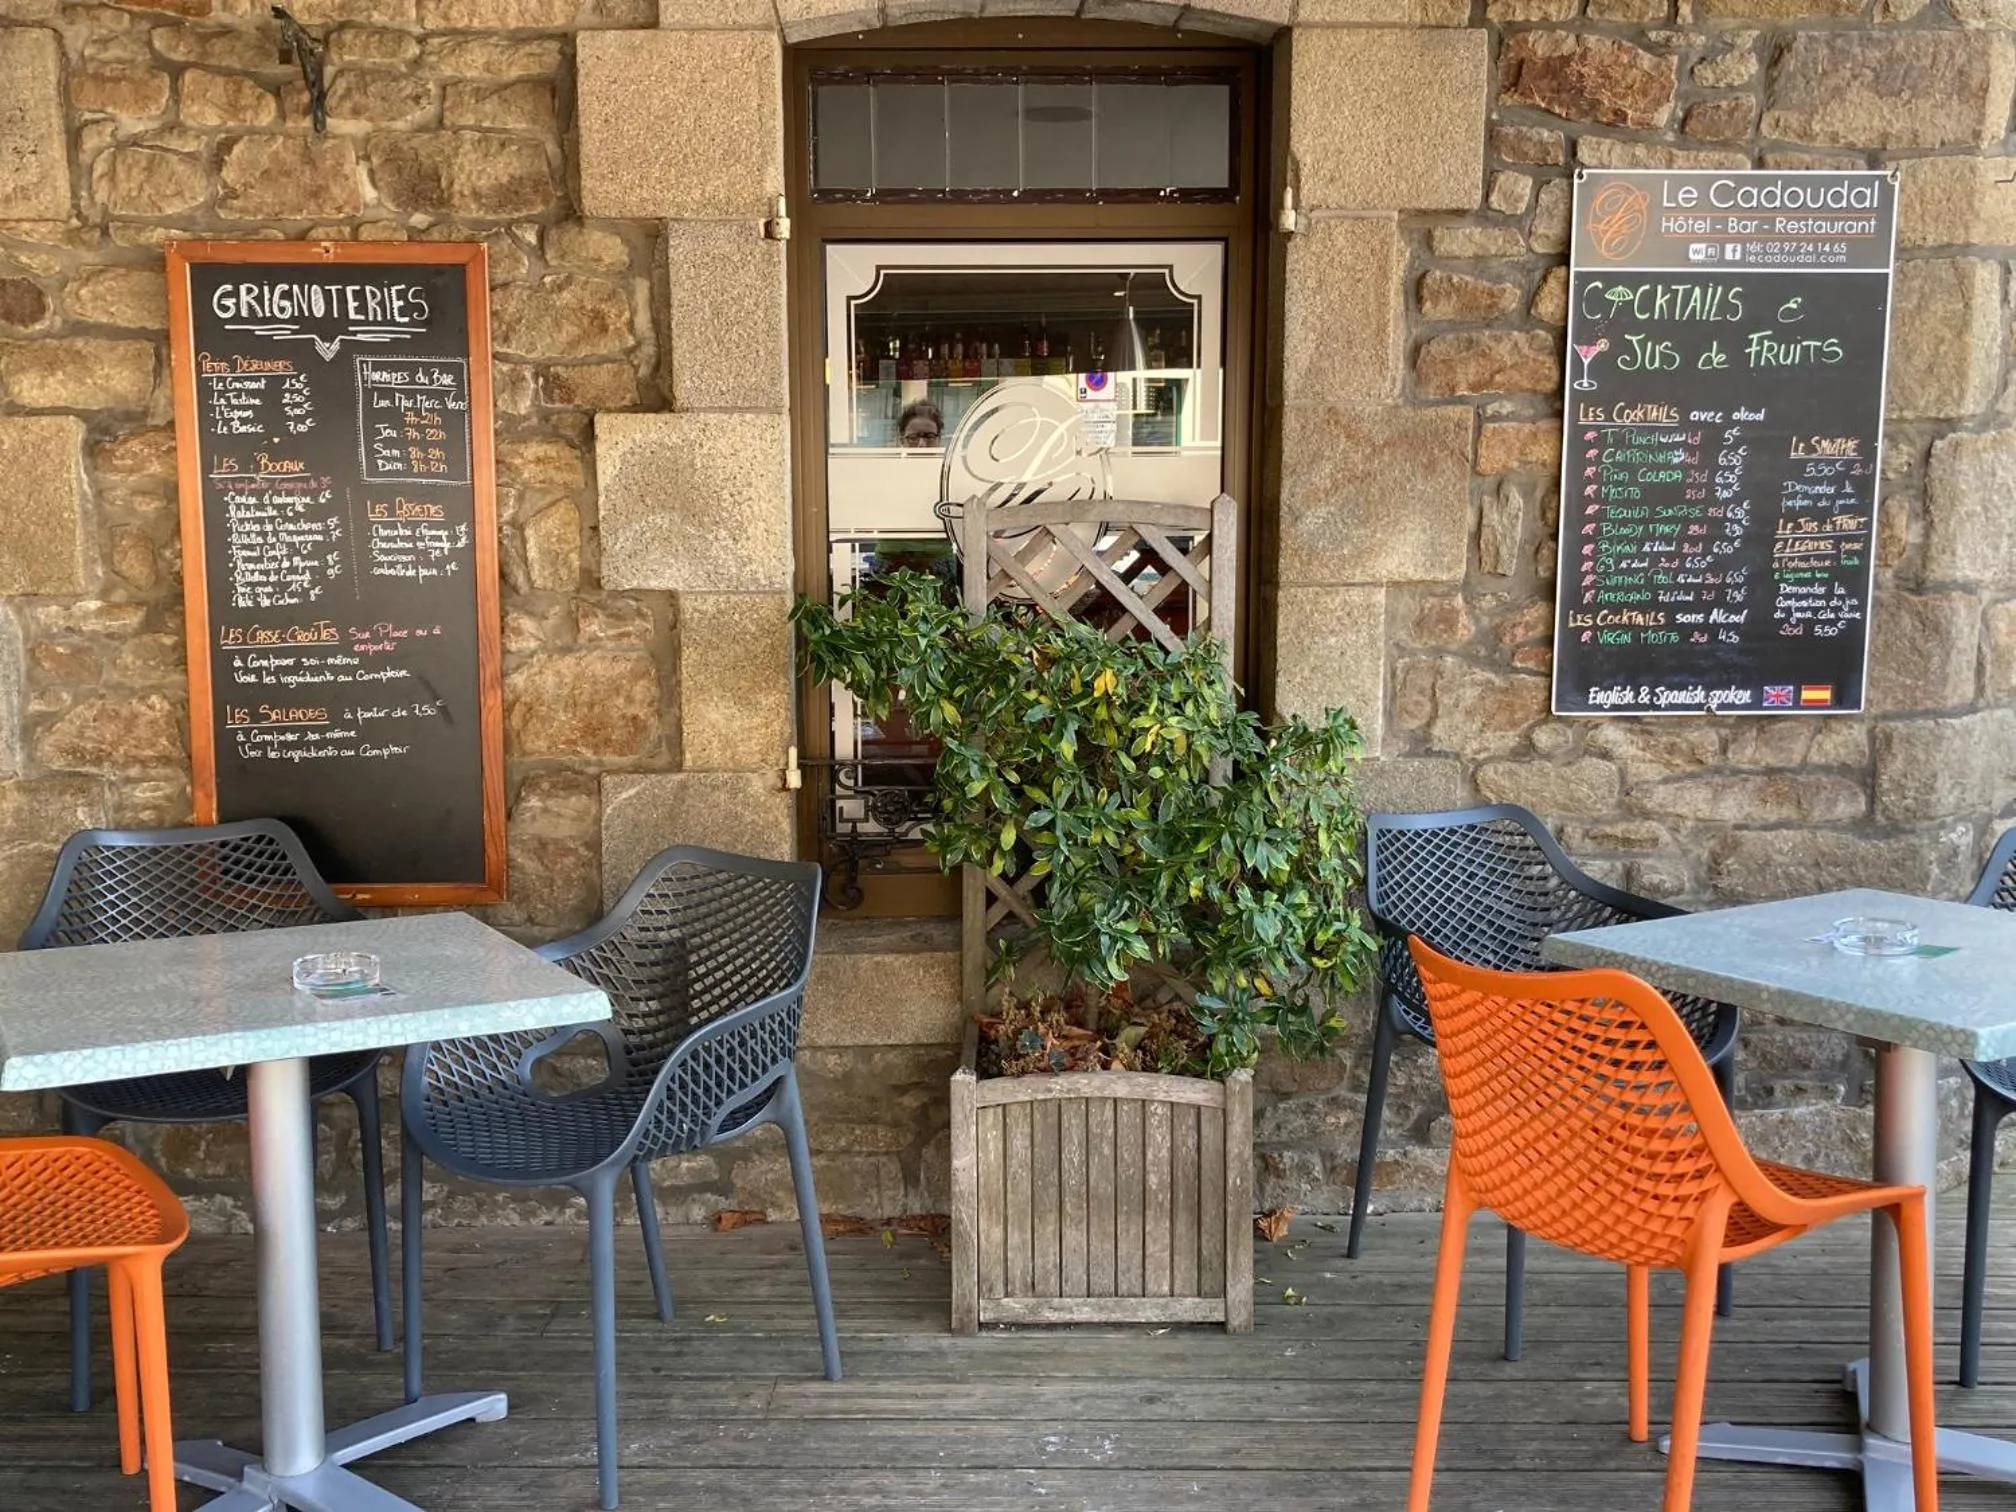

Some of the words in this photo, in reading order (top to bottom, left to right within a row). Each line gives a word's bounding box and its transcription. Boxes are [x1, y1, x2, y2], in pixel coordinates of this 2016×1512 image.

[1662, 179, 1697, 208] Le
[1709, 179, 1879, 209] Cadoudal
[1661, 216, 1710, 233] Hôtel
[1727, 218, 1759, 233] Bar
[1775, 218, 1876, 234] Restaurant
[1746, 241, 1762, 252] tél:
[1766, 242, 1778, 252] 02
[1783, 242, 1797, 252] 97
[1800, 242, 1813, 252] 24
[1817, 242, 1829, 252] 14
[1833, 242, 1847, 252] 65
[1746, 253, 1846, 263] lecadoudal.com
[212, 281, 429, 322] GRIGNOTERIES
[1617, 333, 1680, 370] JUS
[1697, 342, 1729, 369] de
[1579, 402, 1605, 422] LES
[1688, 410, 1724, 424] avec
[1588, 685, 1636, 708] English
[1638, 686, 1651, 704] &
[1654, 685, 1706, 708] Spanish
[1707, 685, 1752, 708] spoken
[227, 704, 250, 724] LES
[259, 704, 329, 723] SALADES
[391, 706, 408, 718] de
